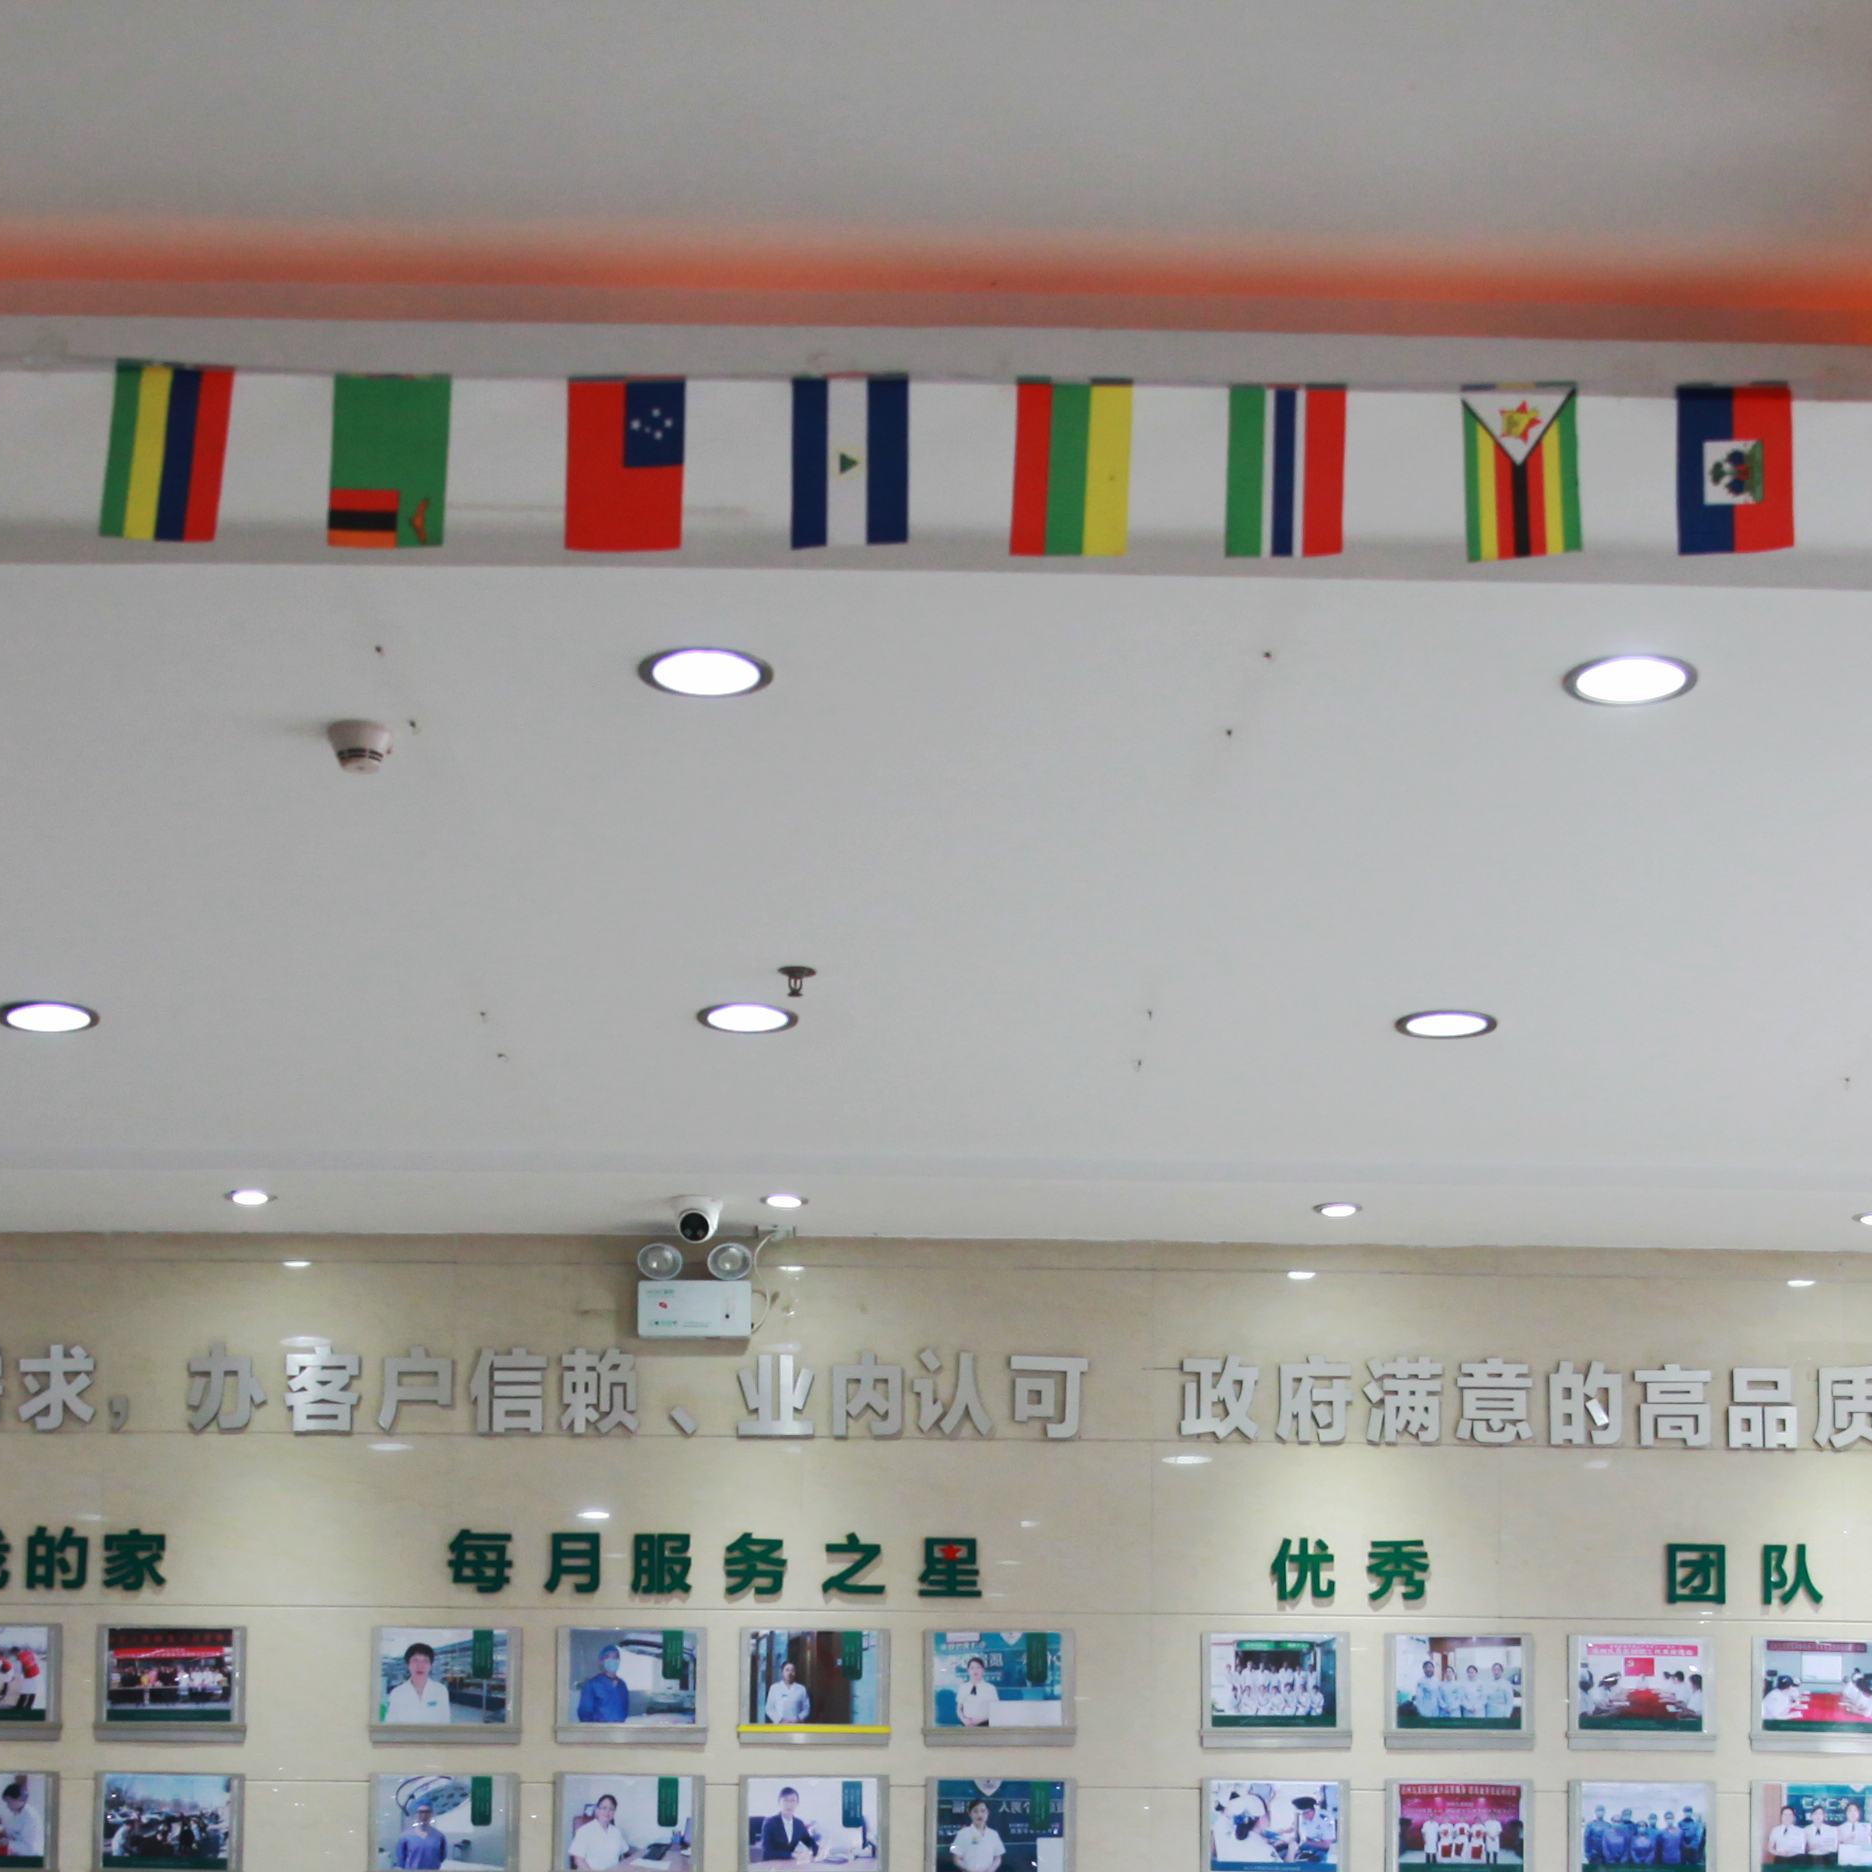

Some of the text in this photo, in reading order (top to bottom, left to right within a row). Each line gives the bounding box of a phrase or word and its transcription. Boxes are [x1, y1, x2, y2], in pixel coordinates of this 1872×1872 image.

[447, 1529, 983, 1600] 每月服务之星
